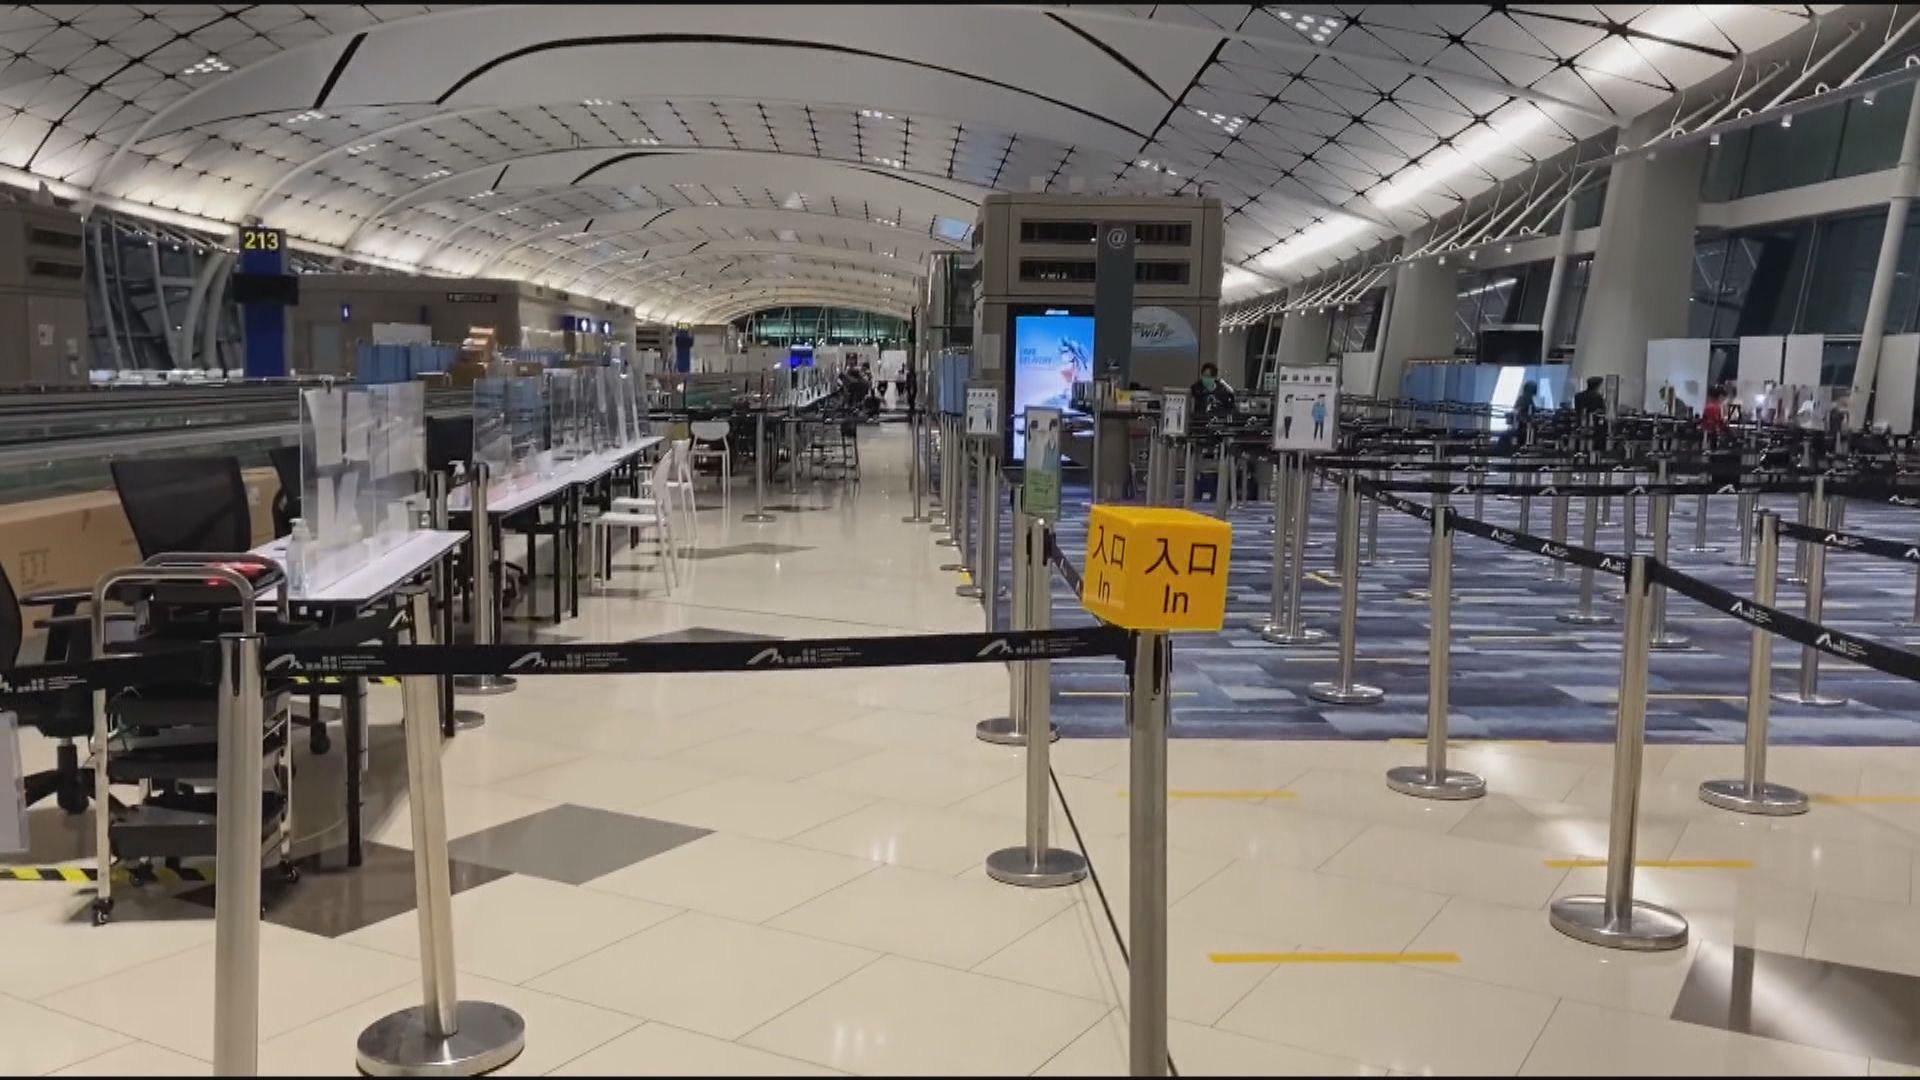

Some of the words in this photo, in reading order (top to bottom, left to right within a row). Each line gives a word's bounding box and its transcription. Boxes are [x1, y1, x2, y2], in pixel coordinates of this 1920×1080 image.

[244, 231, 279, 250] 213
[1093, 525, 1126, 572] 入口
[1144, 538, 1218, 576] 入口
[1098, 570, 1111, 605] In
[1162, 583, 1189, 614] In
